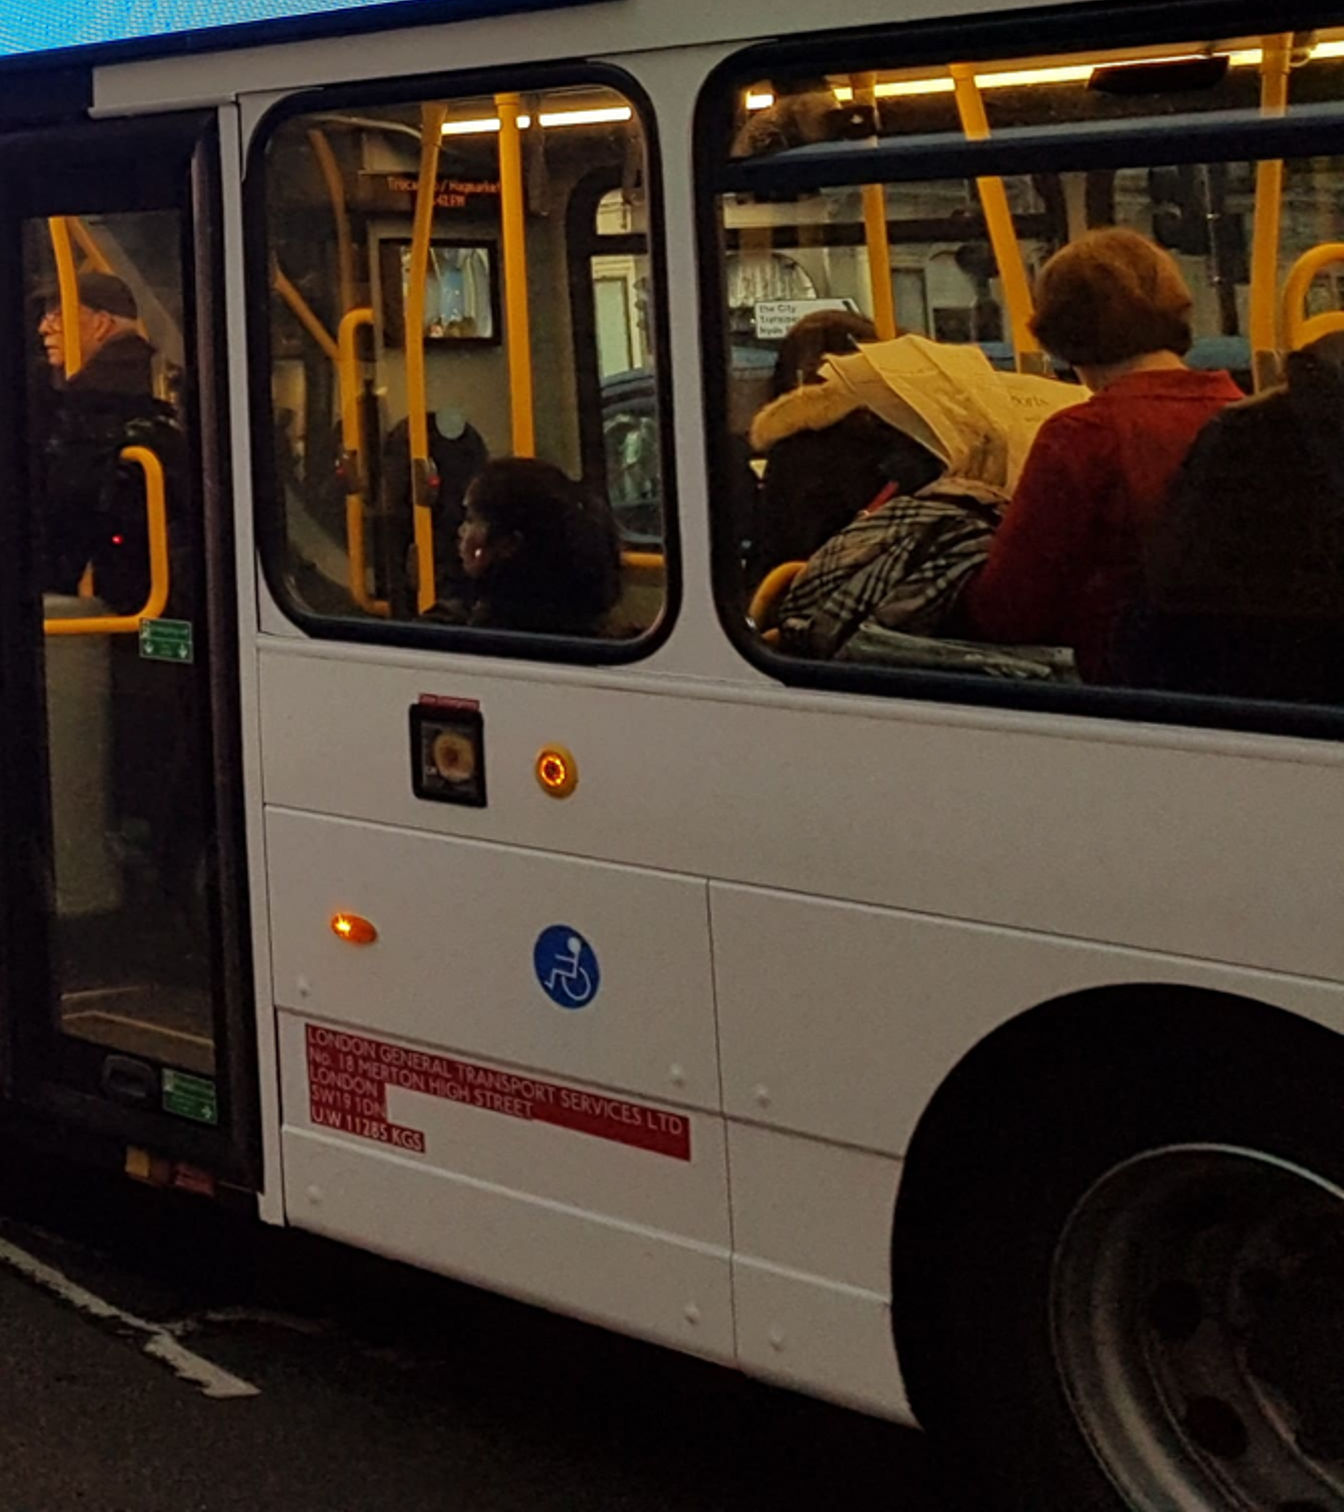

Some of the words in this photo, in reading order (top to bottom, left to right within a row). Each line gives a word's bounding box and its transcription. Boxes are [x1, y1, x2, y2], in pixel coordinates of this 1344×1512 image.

[308, 1027, 376, 1058] LONDON
[380, 1046, 452, 1077] GENERAL
[456, 1063, 556, 1103] TRANSPORT
[560, 1089, 642, 1126] SERVICES
[647, 1111, 683, 1135] LTD
[310, 1065, 378, 1097] LONDON
[311, 1084, 351, 1108] SW19
[358, 1059, 424, 1090] MERTON
[429, 1078, 470, 1101] HIGH
[473, 1089, 533, 1117] STREET
[393, 1128, 423, 1150] KGS
